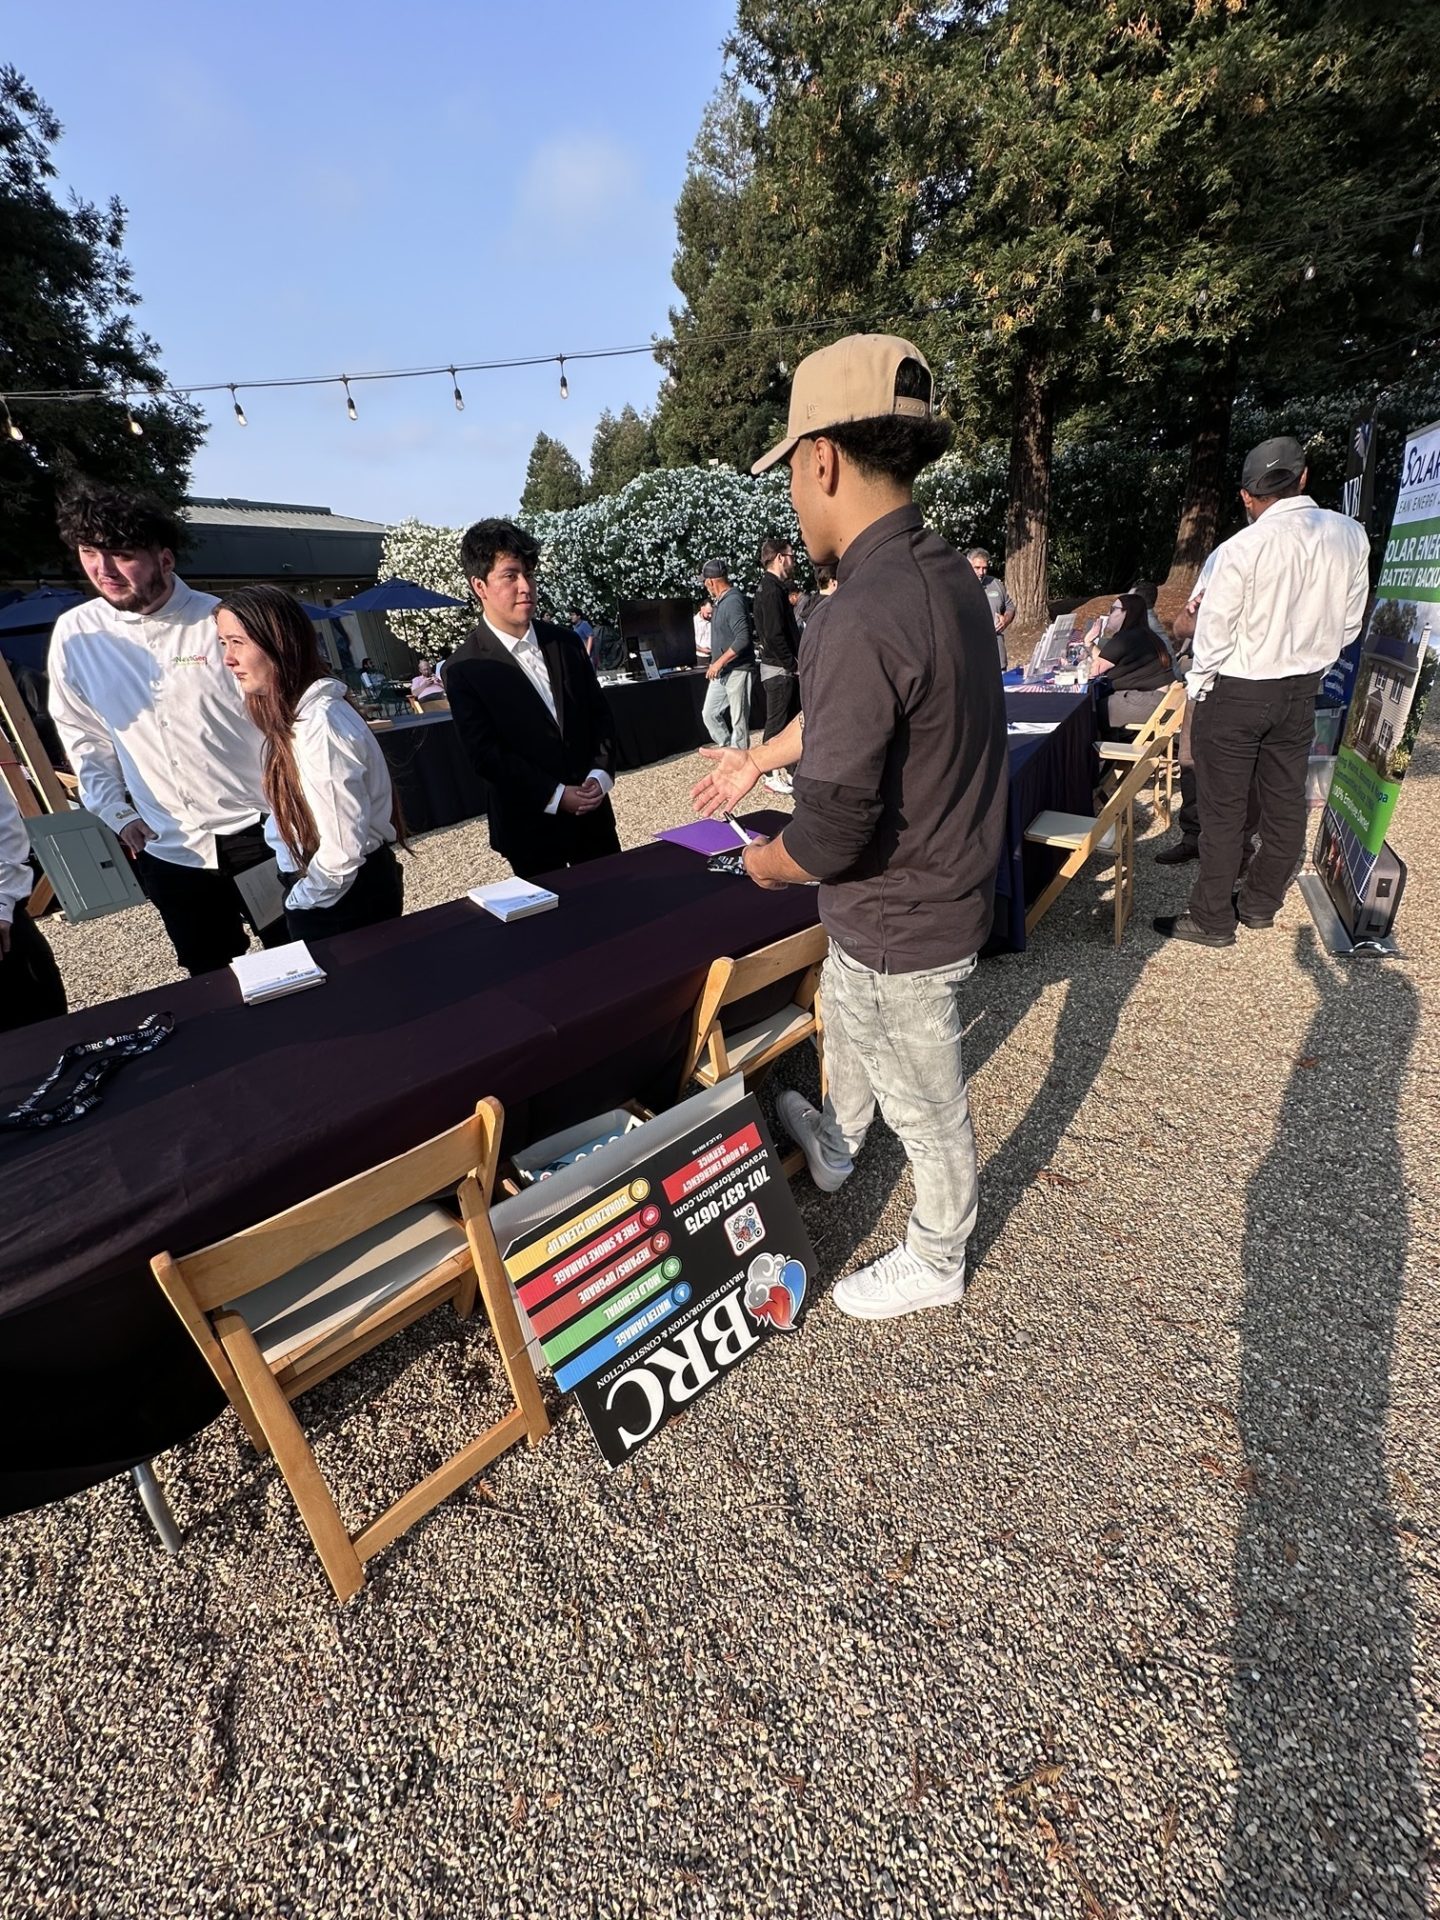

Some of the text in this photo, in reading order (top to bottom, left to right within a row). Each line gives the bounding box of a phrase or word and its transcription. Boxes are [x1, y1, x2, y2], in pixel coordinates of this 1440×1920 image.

[1401, 446, 1440, 489] SOLAR
[1384, 537, 1417, 562] OLAR
[1381, 567, 1418, 587] BATTERY
[85, 1041, 104, 1052] BRC
[116, 1033, 135, 1043] BRC
[697, 1144, 727, 1169] SERVICE
[721, 1148, 741, 1167] HOUR
[739, 1142, 750, 1154] 24
[673, 1149, 769, 1218] bravorestoration.com
[682, 1160, 722, 1193] EMERGENCY
[684, 1165, 771, 1235] 707-837-0675
[546, 1194, 630, 1254] BIOHAZARD CLEAN UP
[552, 1220, 641, 1286] FIRE & SMOKE DAMAGE
[577, 1271, 616, 1304] UPGRADE
[603, 1272, 661, 1320] MOLD REMOVAL
[597, 1270, 745, 1389] BRAVO RESTORATION & CONSTRUCTION
[614, 1298, 672, 1347] WATER DAMAGE
[606, 1287, 760, 1450] BRC
